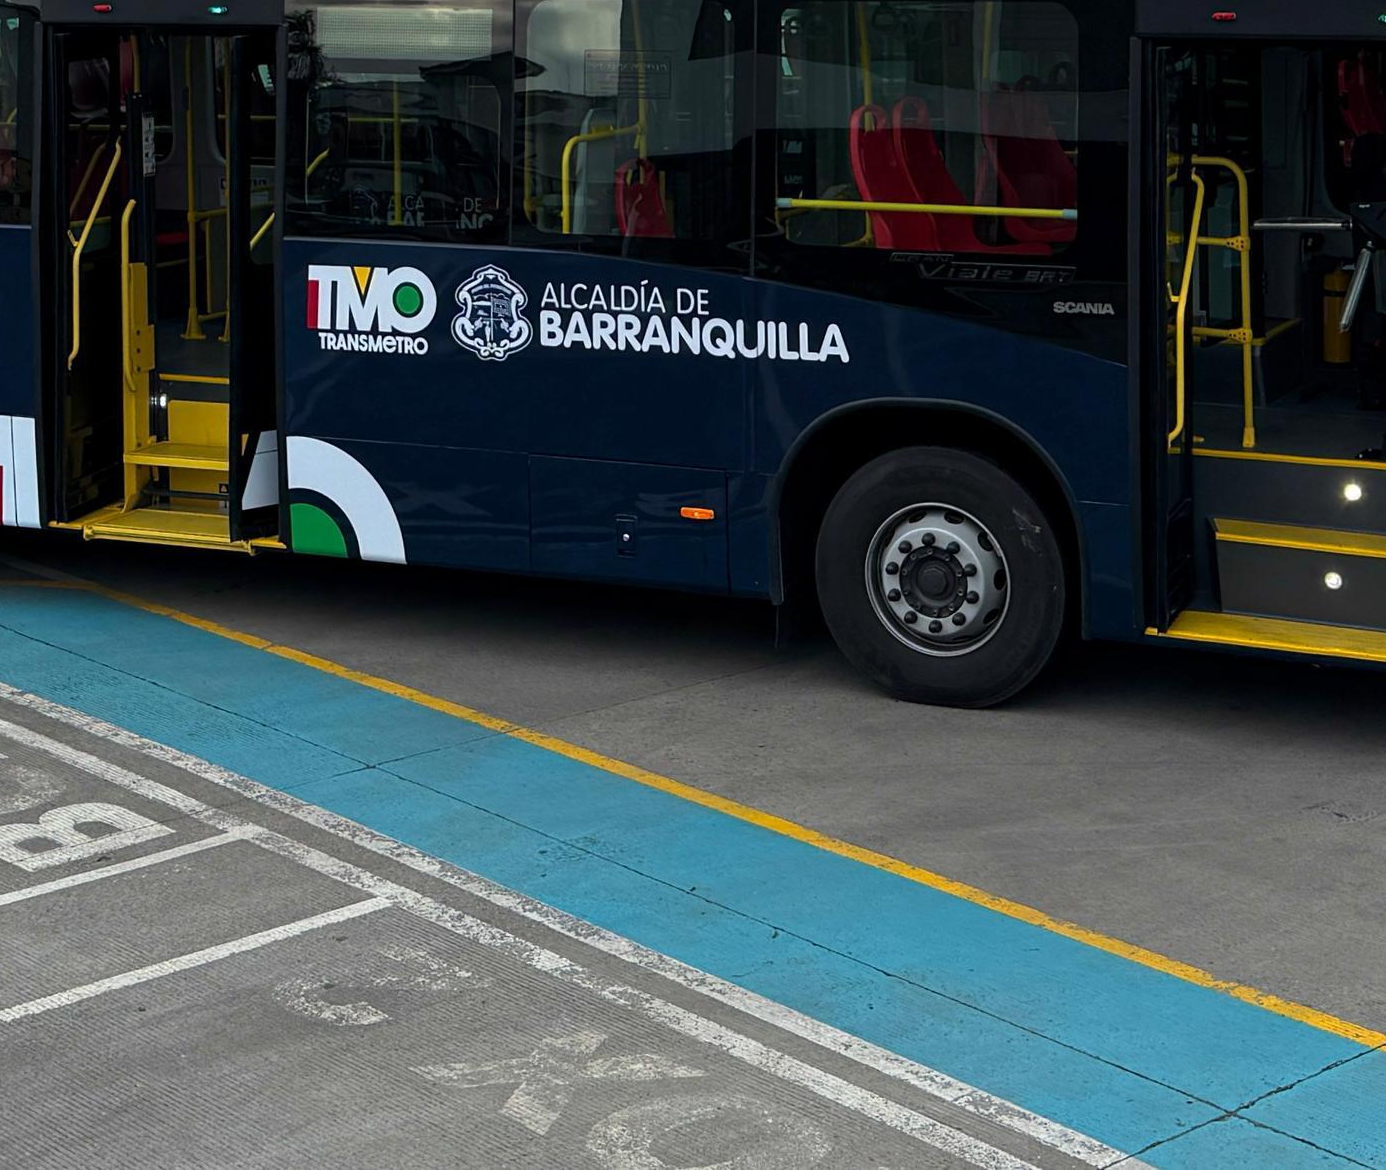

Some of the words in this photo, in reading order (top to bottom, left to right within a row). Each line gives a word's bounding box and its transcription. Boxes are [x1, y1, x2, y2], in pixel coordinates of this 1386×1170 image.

[306, 264, 438, 334] TMO
[541, 280, 666, 314] ALCALDÍA
[676, 288, 710, 315] DE
[1053, 301, 1115, 315] SCANIA
[540, 310, 850, 364] BARRANQUILLA
[409, 1031, 833, 1170] OX
